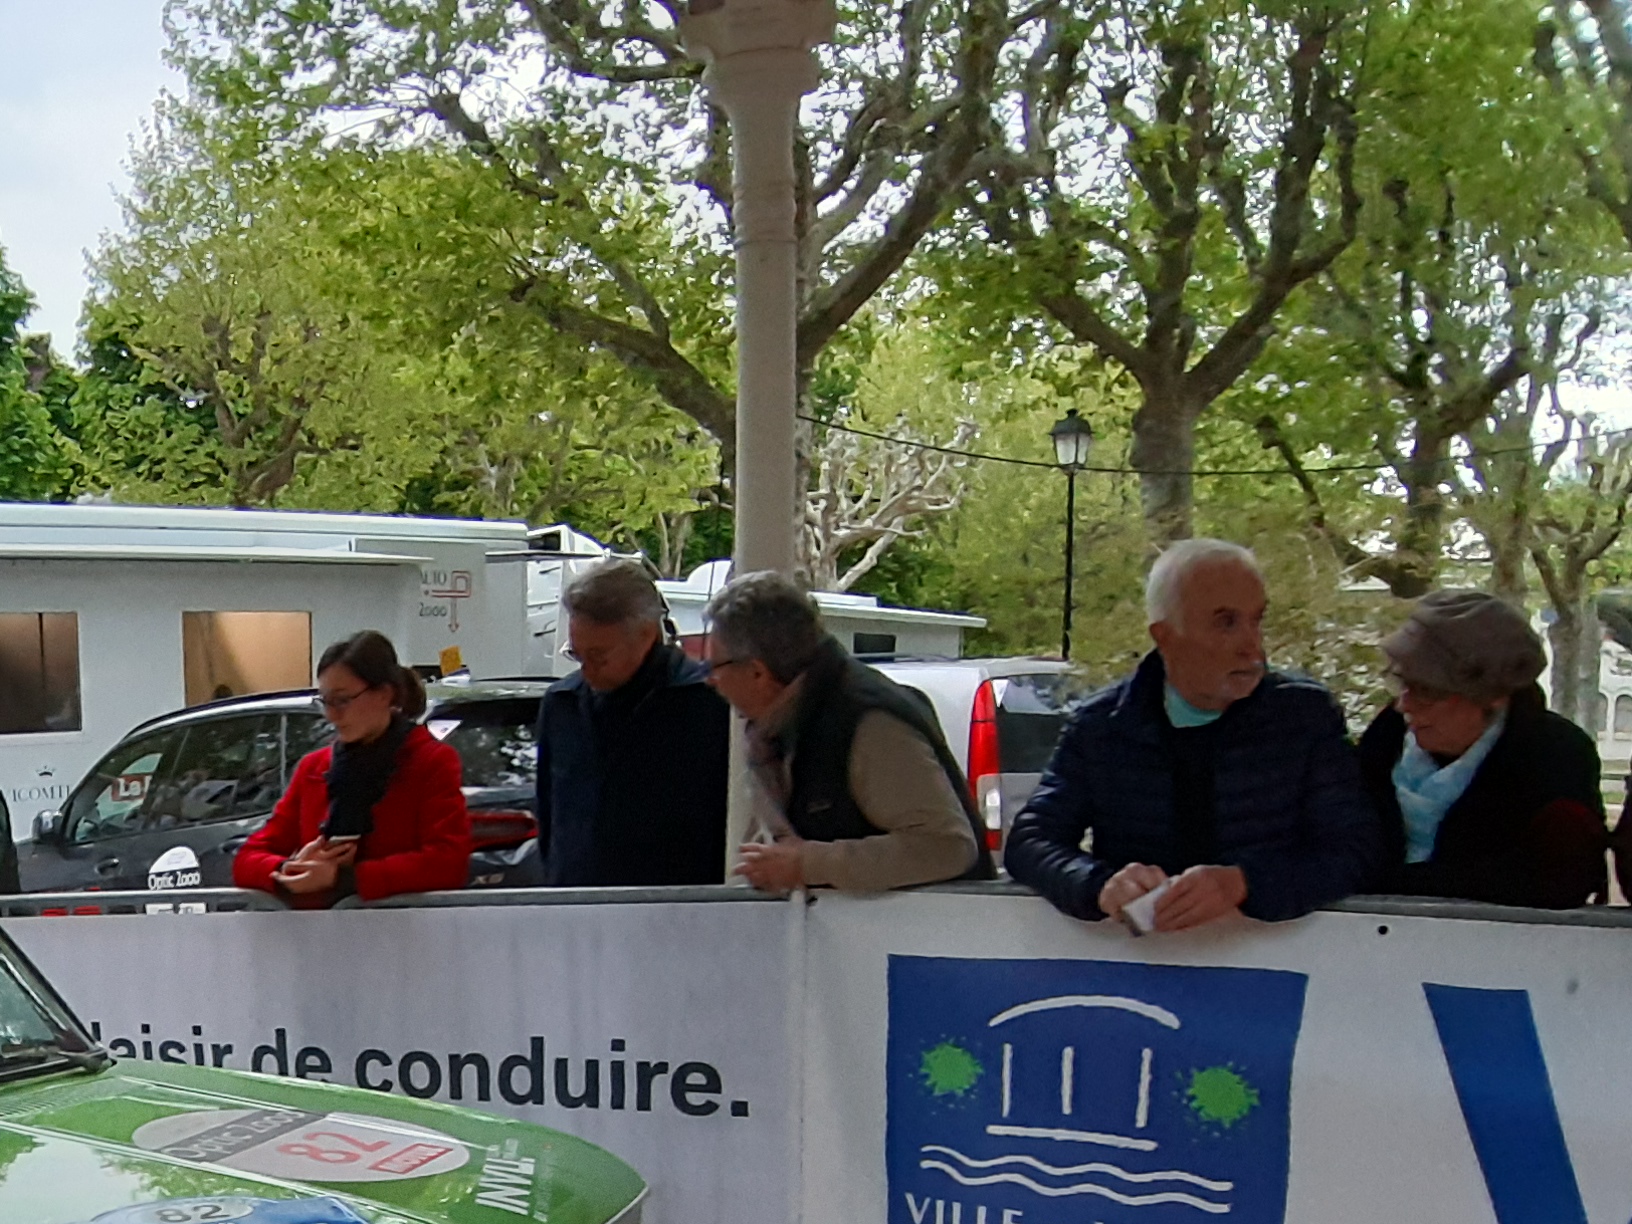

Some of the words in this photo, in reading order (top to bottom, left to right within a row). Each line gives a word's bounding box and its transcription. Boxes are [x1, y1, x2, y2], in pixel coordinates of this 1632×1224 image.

[251, 1027, 334, 1081] de
[355, 1036, 750, 1117] conduire.
[275, 1130, 391, 1164] 82
[154, 1203, 231, 1224] 82
